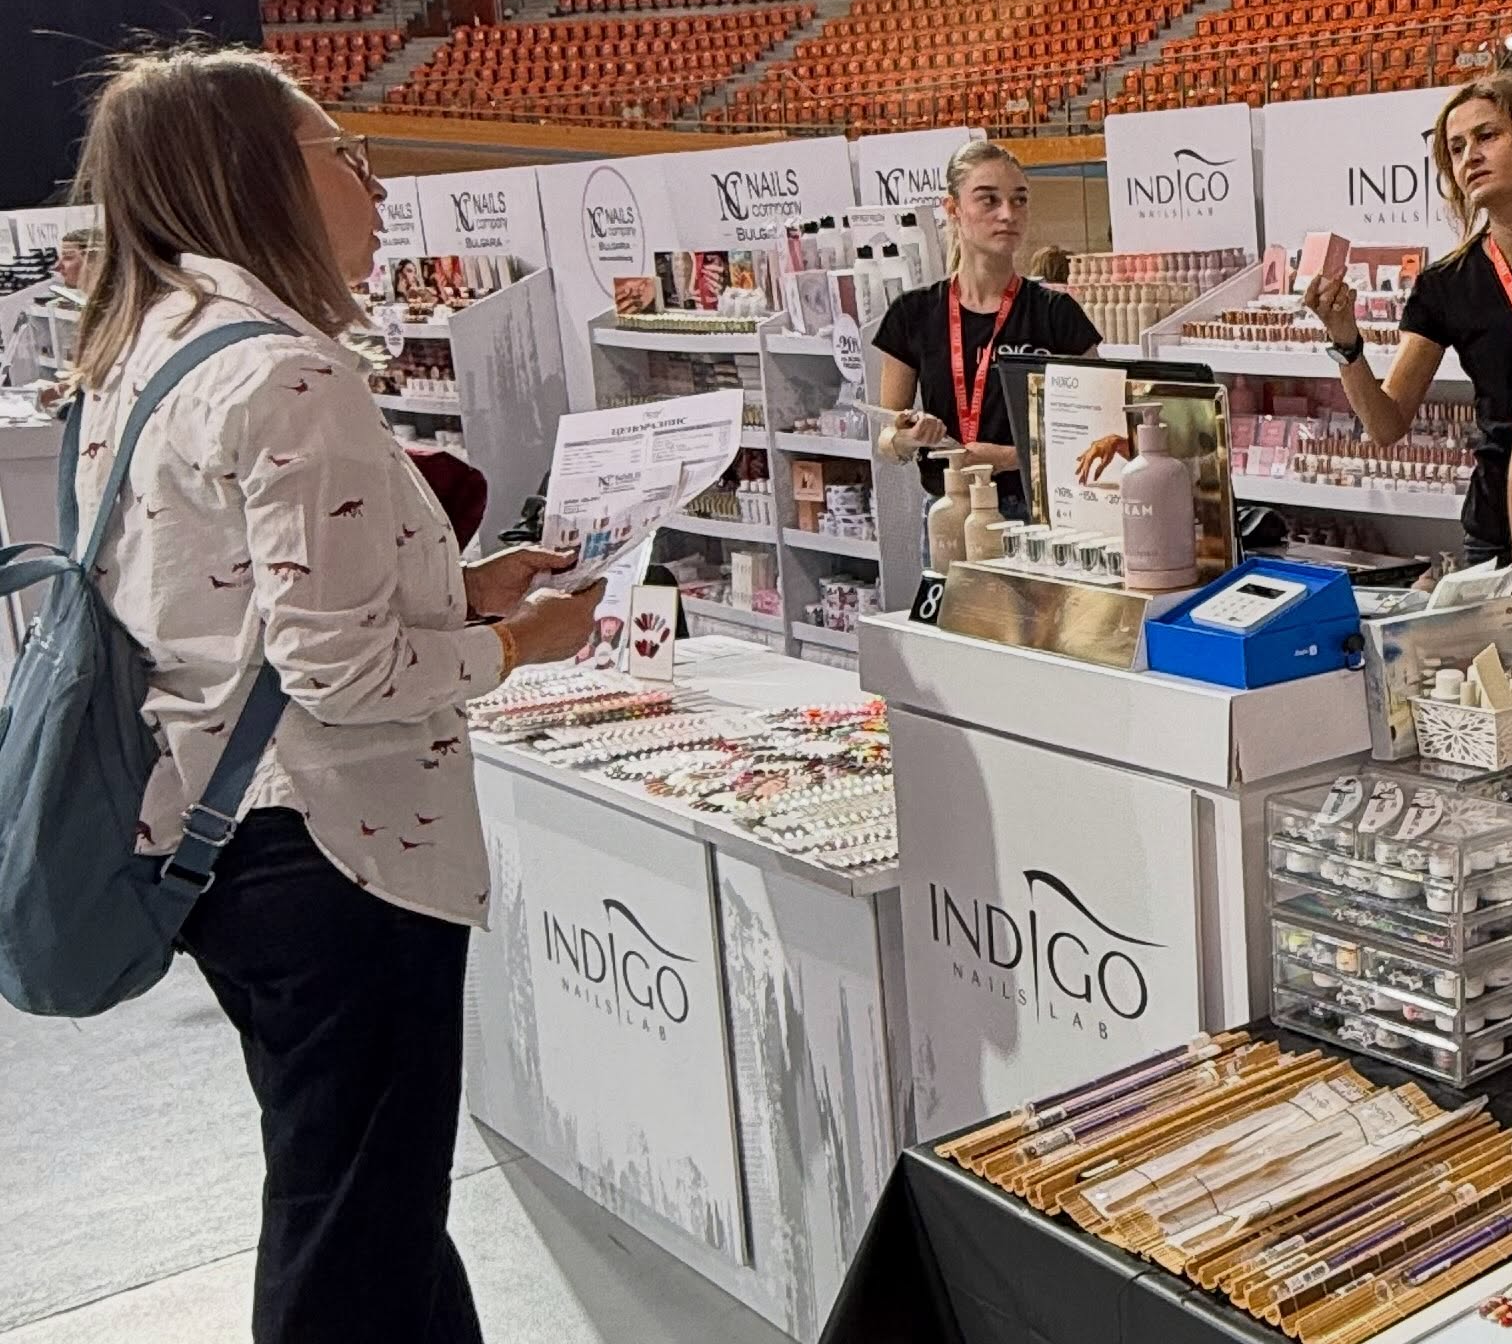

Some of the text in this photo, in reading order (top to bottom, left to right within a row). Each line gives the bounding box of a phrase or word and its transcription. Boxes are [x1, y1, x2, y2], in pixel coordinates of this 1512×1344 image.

[745, 168, 800, 200] NAILS
[908, 167, 948, 193] NAIL
[1126, 168, 1230, 208] INDIGO
[472, 191, 507, 215] NAILS
[918, 582, 944, 620] 8
[543, 909, 690, 1025] INDIGO
[929, 882, 1148, 1022] INDIGO
[561, 976, 613, 1015] NAILS
[952, 961, 1108, 1040] NAILS LAB
